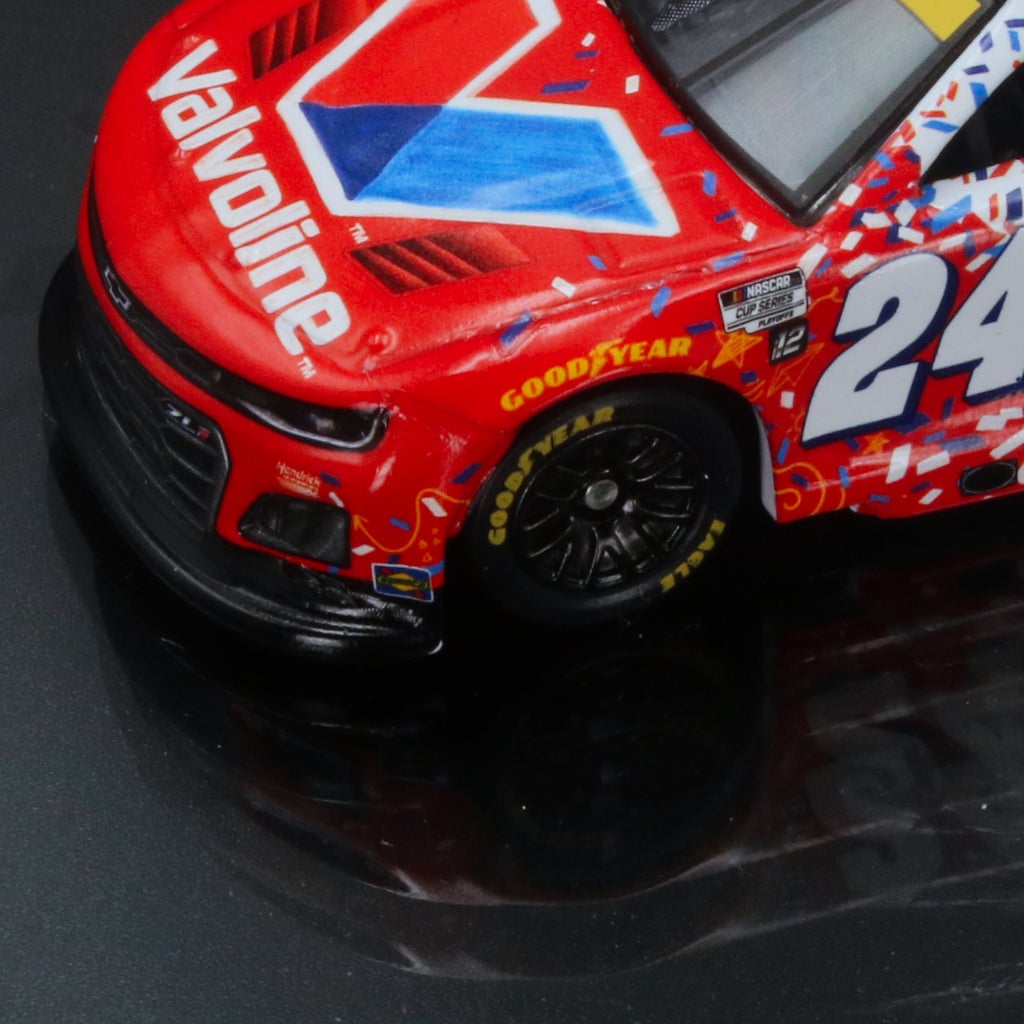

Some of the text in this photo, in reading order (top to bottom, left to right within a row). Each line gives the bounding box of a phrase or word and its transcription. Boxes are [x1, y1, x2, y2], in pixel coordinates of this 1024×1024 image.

[147, 39, 351, 356] Valvoline
[736, 291, 794, 319] CUP SERIES
[746, 275, 791, 299] NASCAR
[500, 337, 692, 412] GOODYEAR
[488, 406, 615, 546] GOODYEAR
